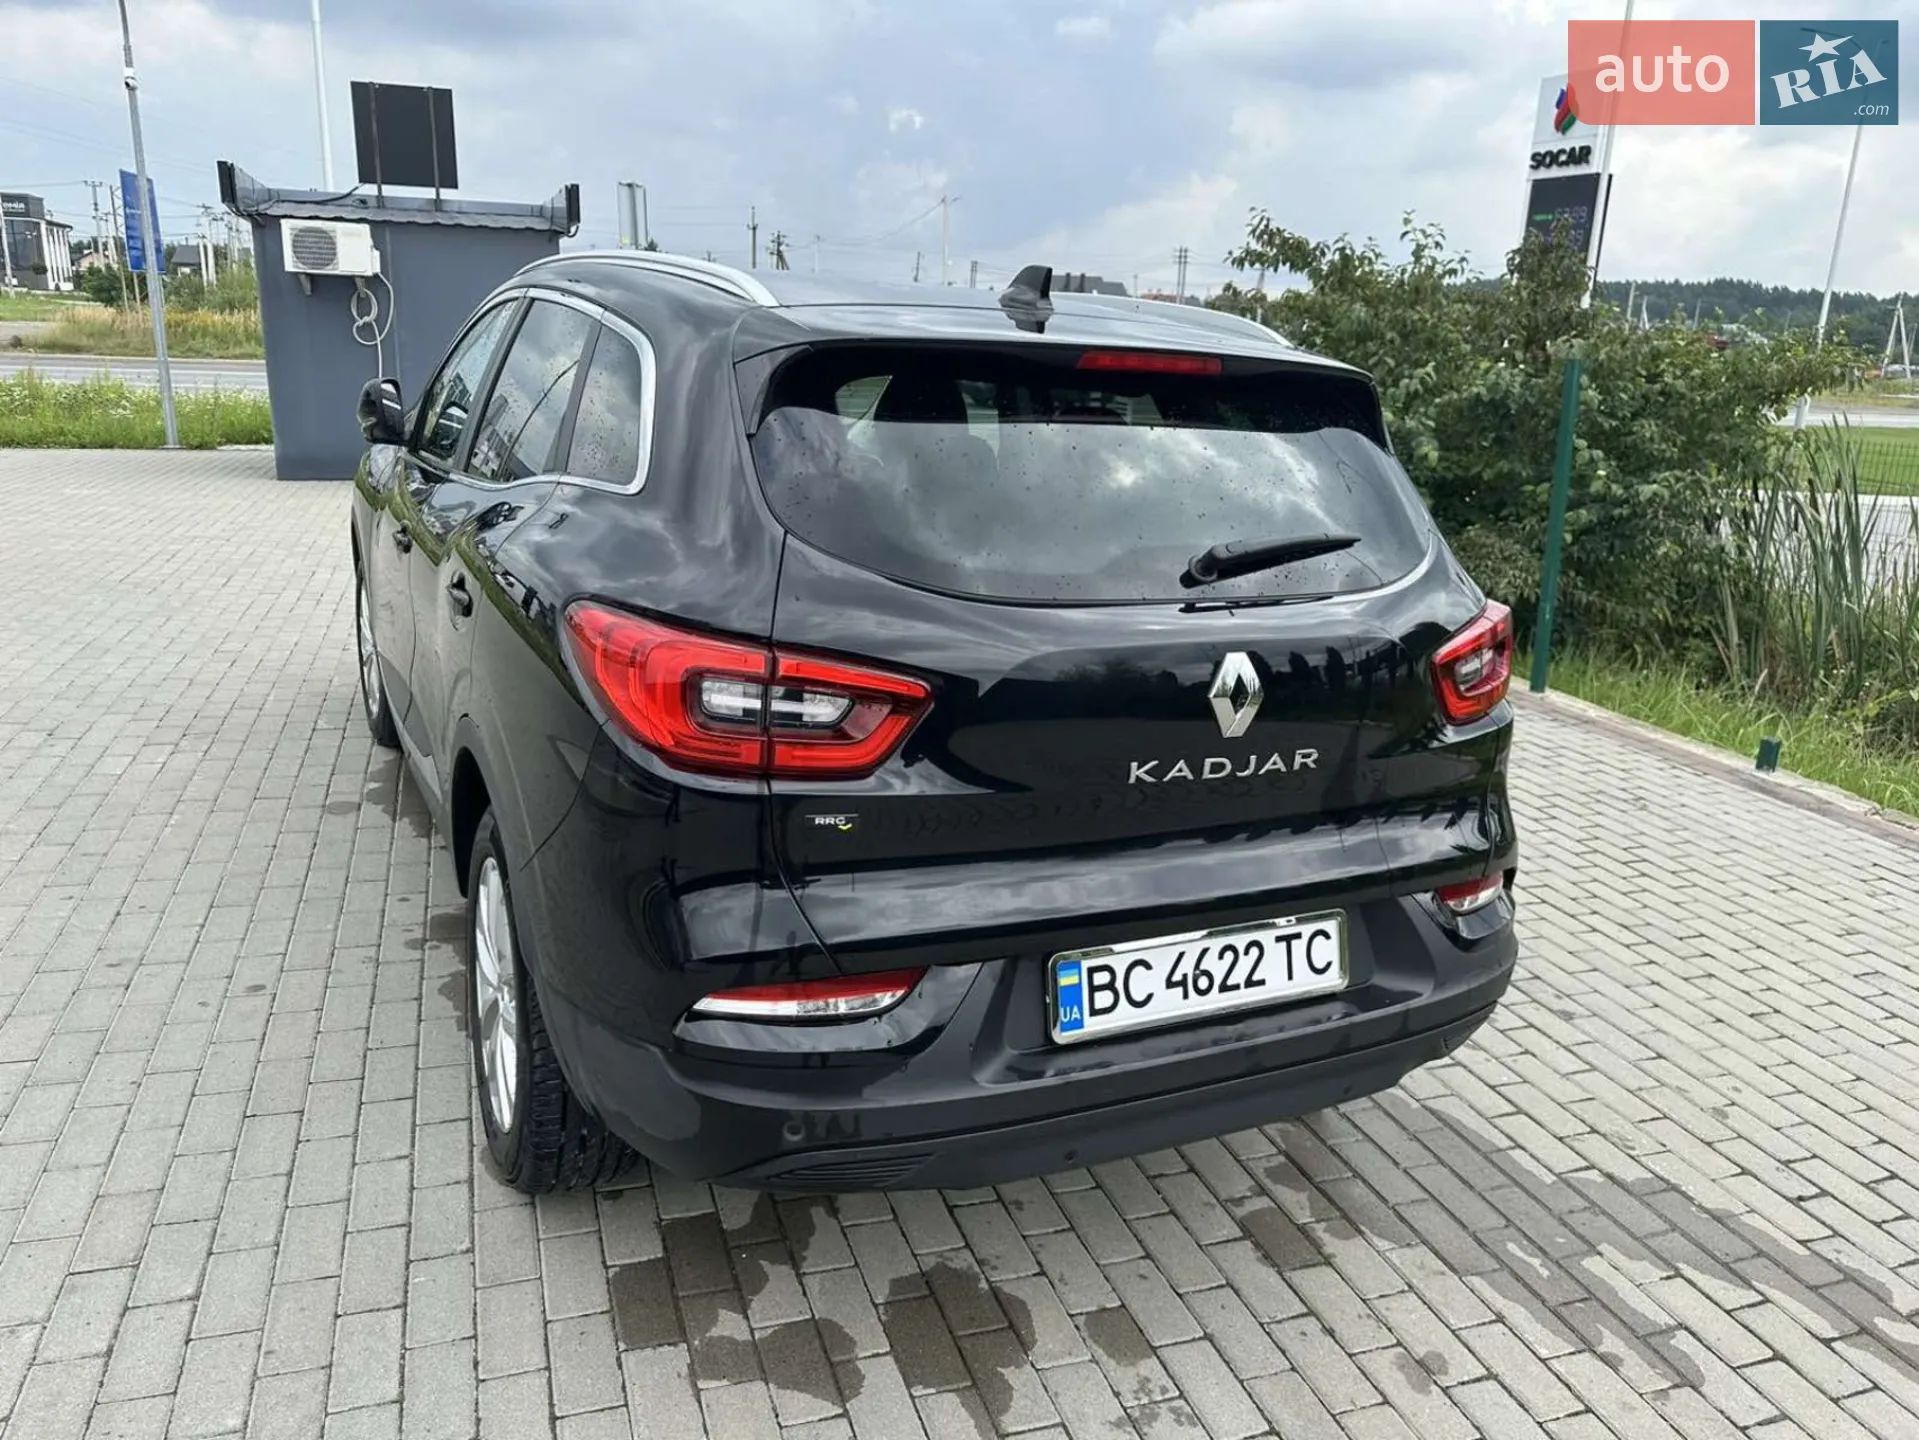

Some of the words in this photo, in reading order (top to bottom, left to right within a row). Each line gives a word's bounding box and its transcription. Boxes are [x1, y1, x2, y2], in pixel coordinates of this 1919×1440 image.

[1529, 145, 1592, 170] SOCAR
[1127, 748, 1320, 784] KADJAR
[1086, 958, 1155, 1018] BC
[1165, 939, 1267, 1000] 4622
[1274, 928, 1334, 982] TC
[1060, 1006, 1081, 1023] UA
